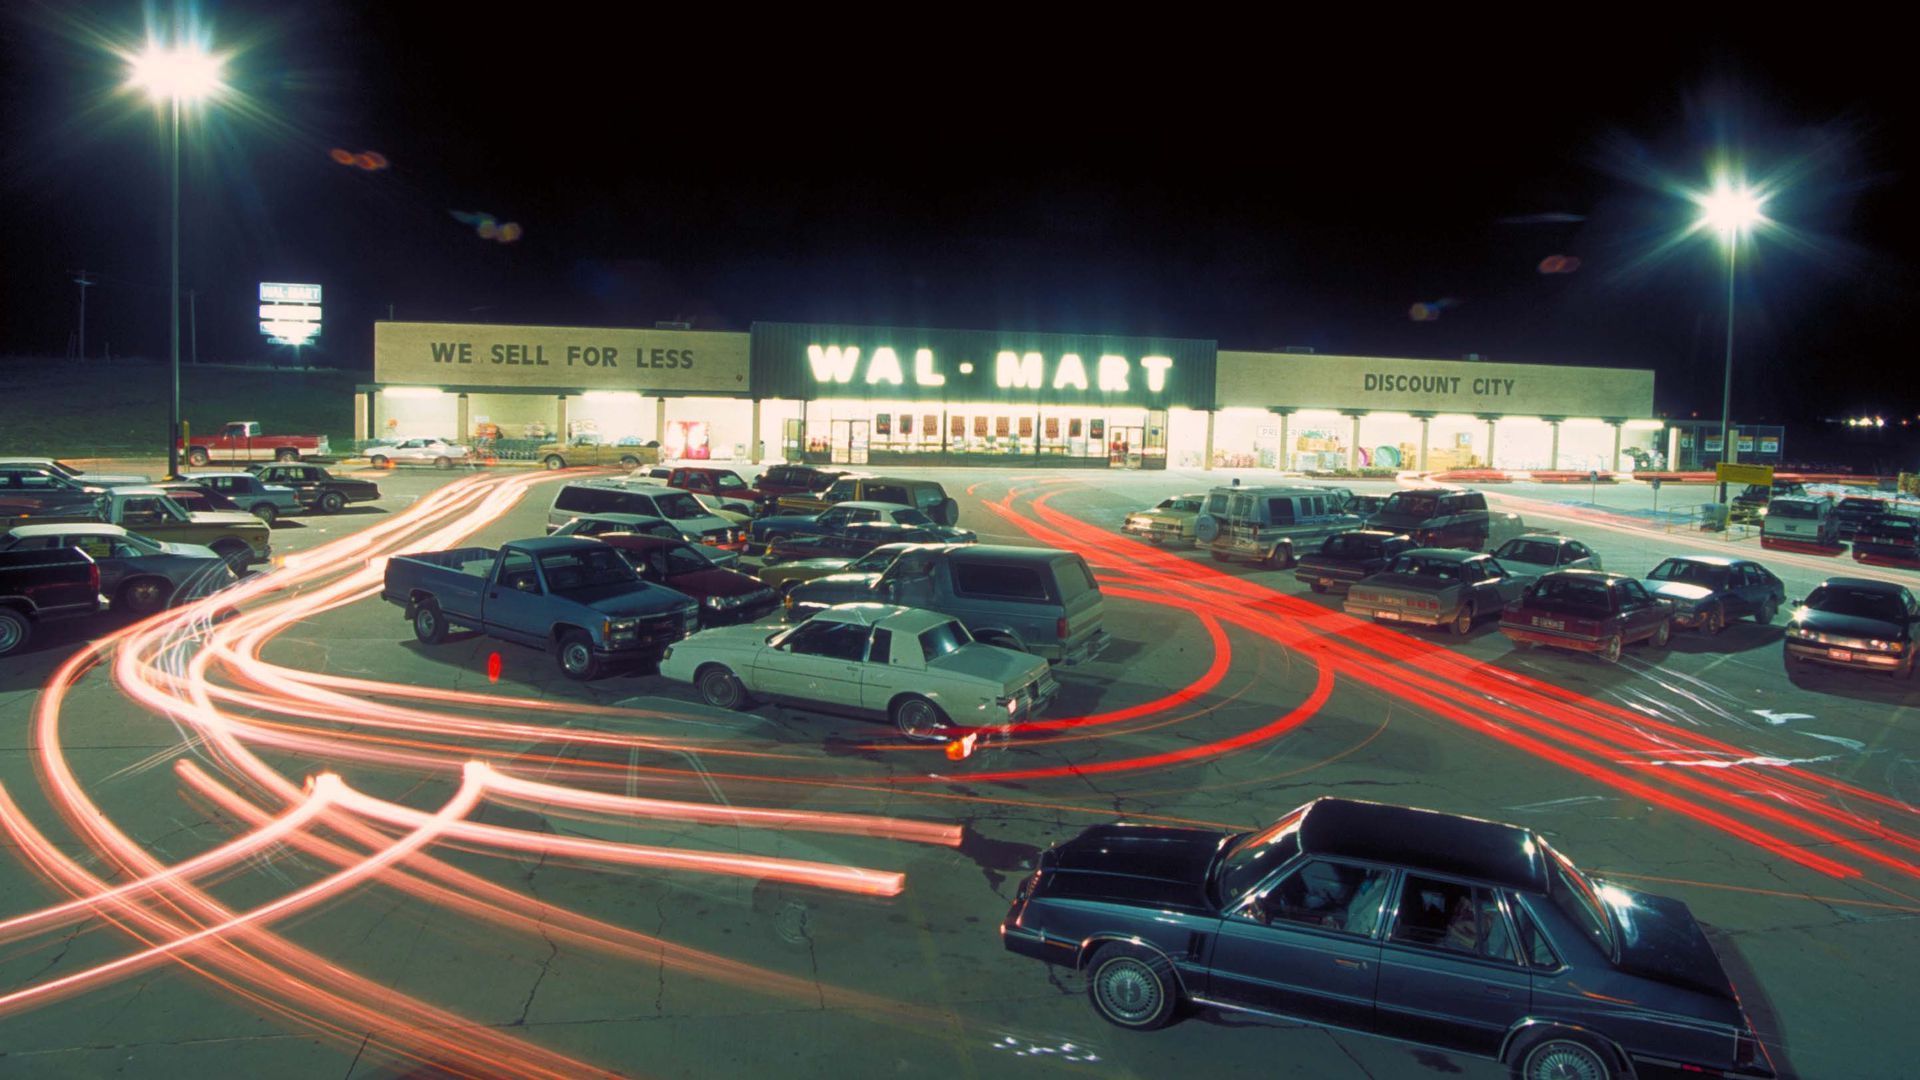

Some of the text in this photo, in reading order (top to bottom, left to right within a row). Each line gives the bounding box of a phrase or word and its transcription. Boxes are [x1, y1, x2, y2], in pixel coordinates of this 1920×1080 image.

[432, 343, 694, 370] WE SELL FOR LESS
[1364, 373, 1515, 395] DISCOUNT CITY
